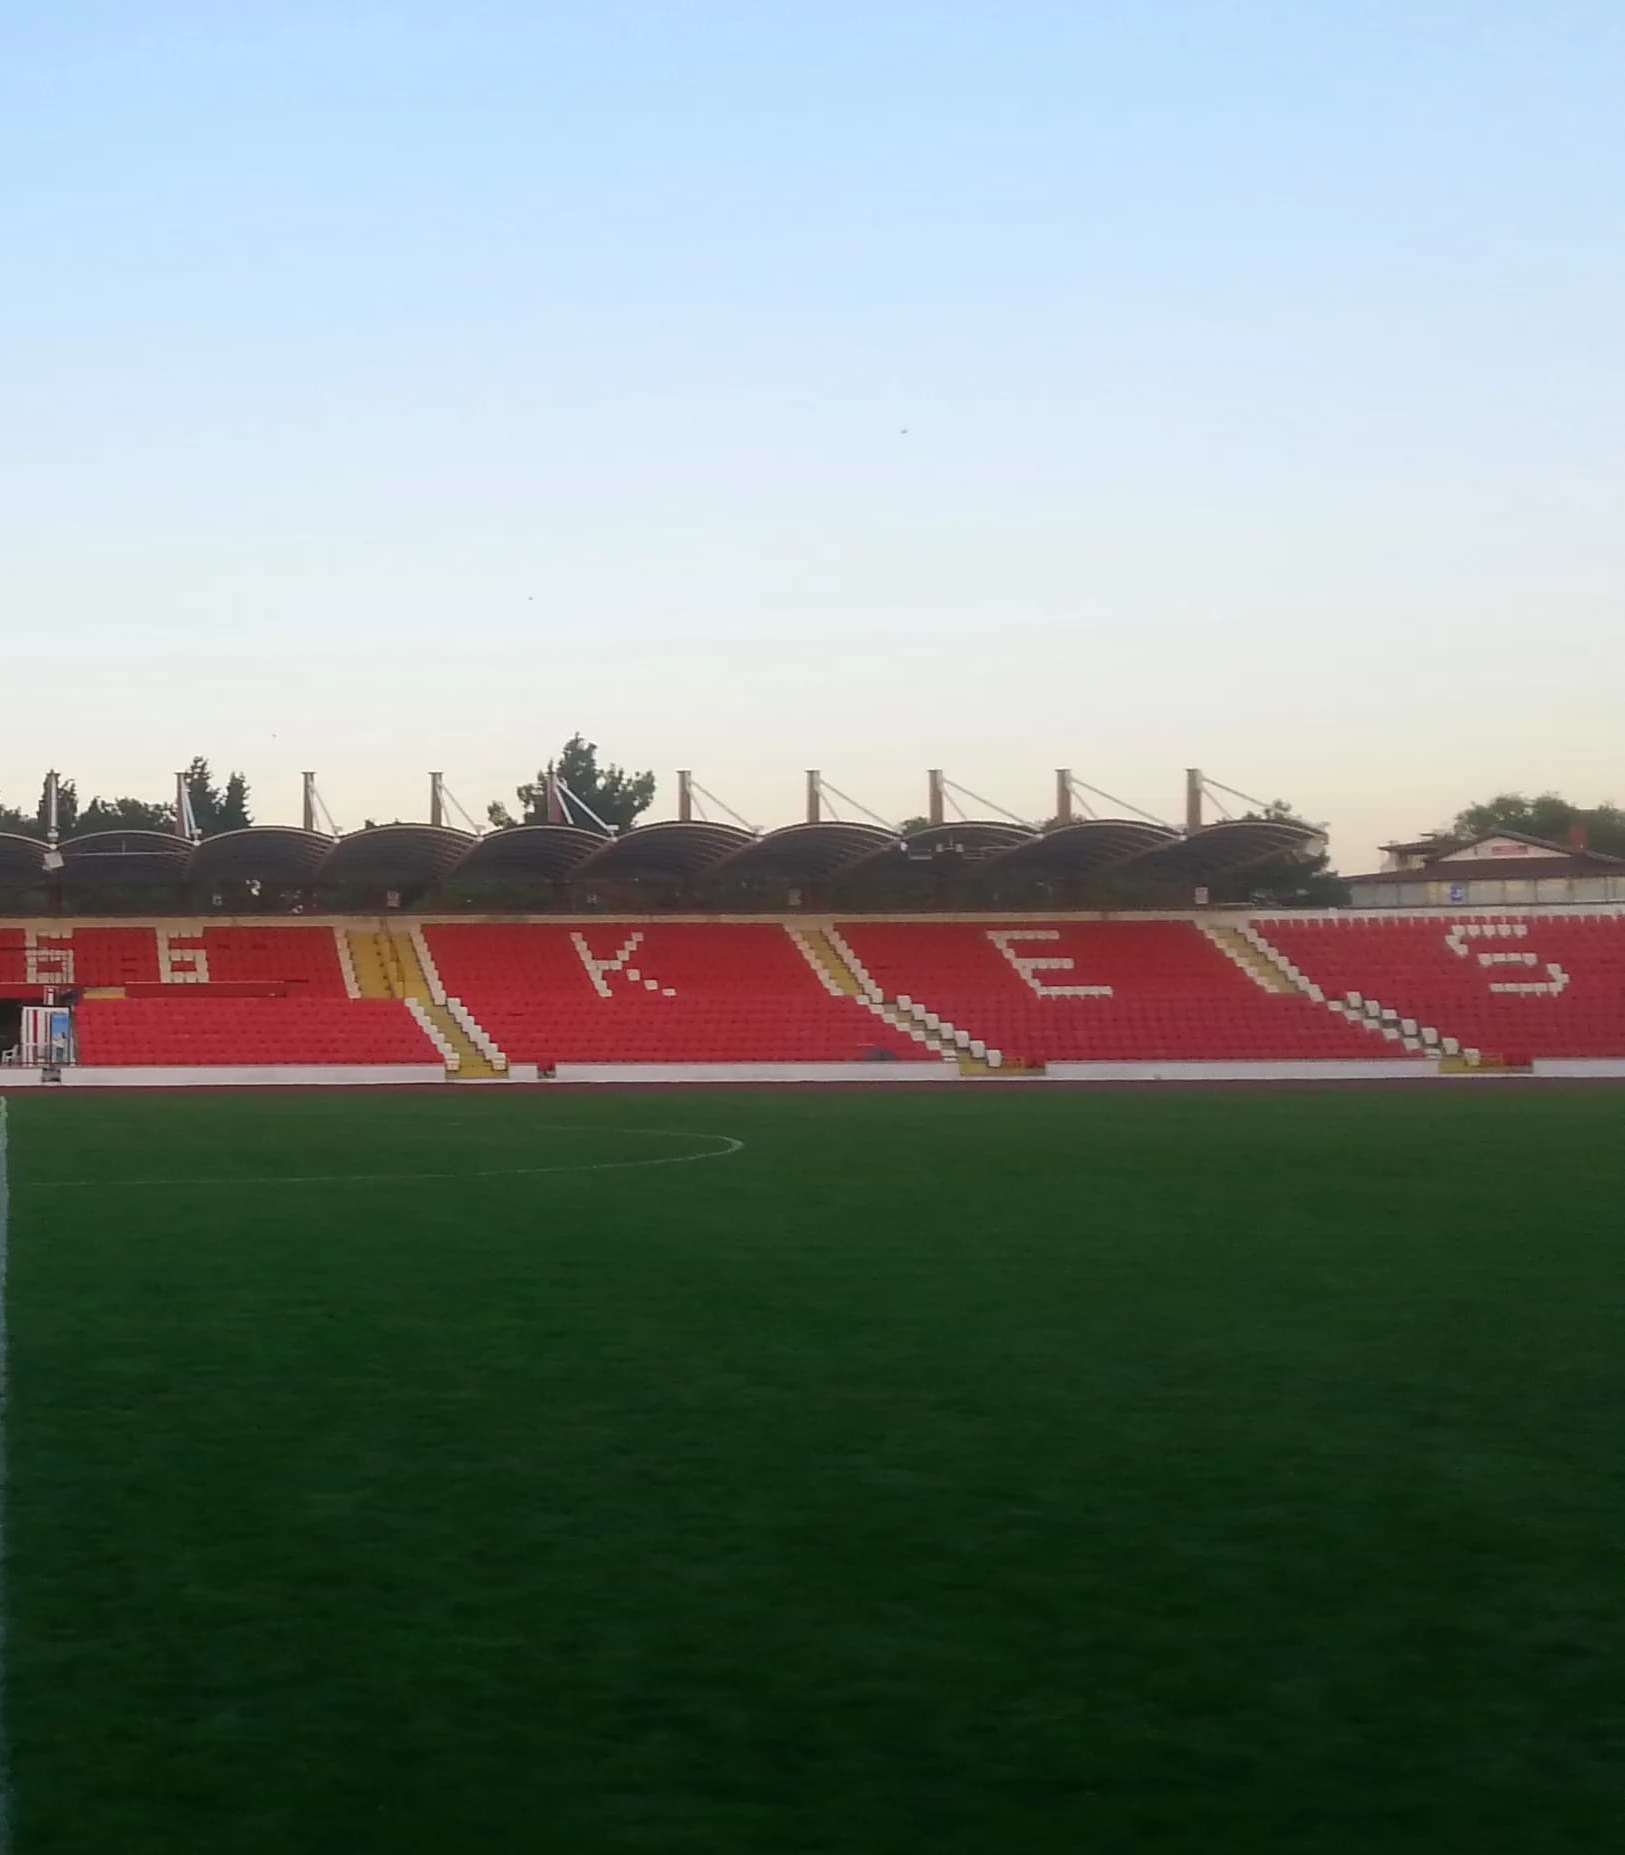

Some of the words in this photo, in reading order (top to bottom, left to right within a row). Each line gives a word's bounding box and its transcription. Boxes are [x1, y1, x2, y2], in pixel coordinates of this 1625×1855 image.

[571, 932, 676, 998] K
[986, 930, 1113, 996] E
[1444, 924, 1570, 996] S
